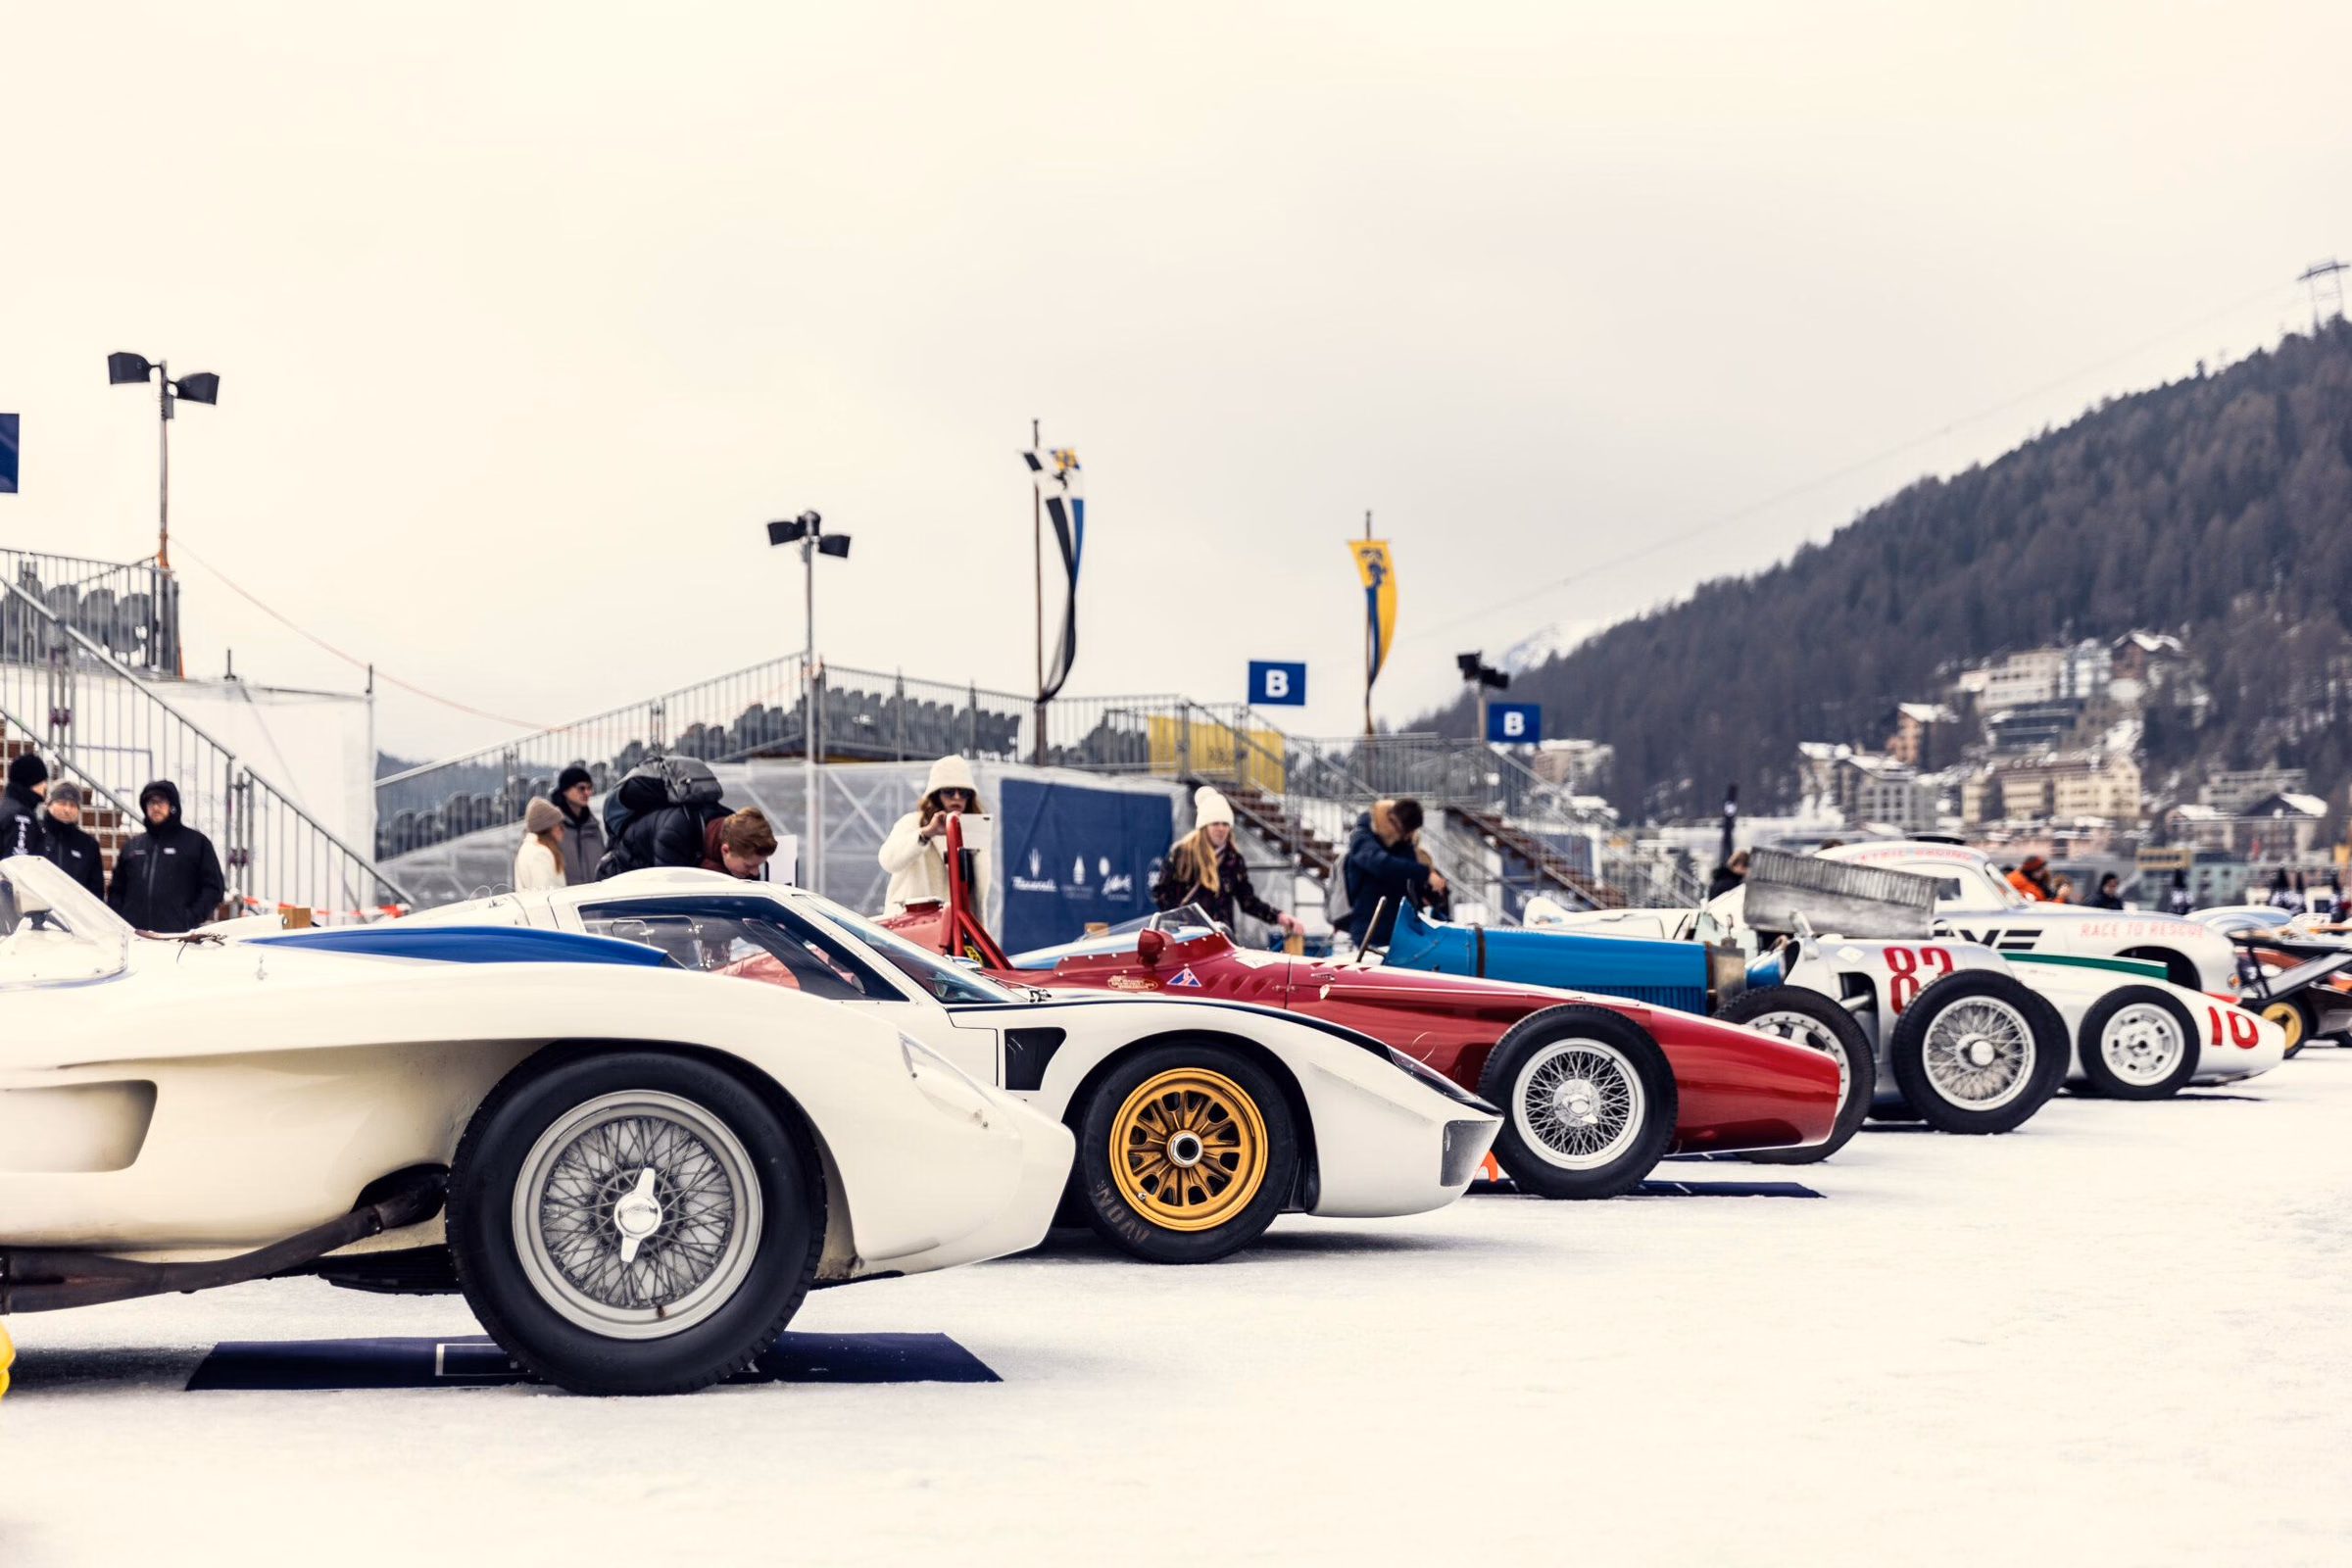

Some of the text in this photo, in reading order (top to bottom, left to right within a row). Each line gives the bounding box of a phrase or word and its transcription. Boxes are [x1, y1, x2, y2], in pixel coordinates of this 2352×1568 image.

[1265, 669, 1290, 698] B
[1503, 710, 1525, 736] B
[2080, 922, 2204, 939] RACE TO RESCUE
[2208, 1005, 2259, 1050] 10
[1095, 1187, 1151, 1244] AVON
